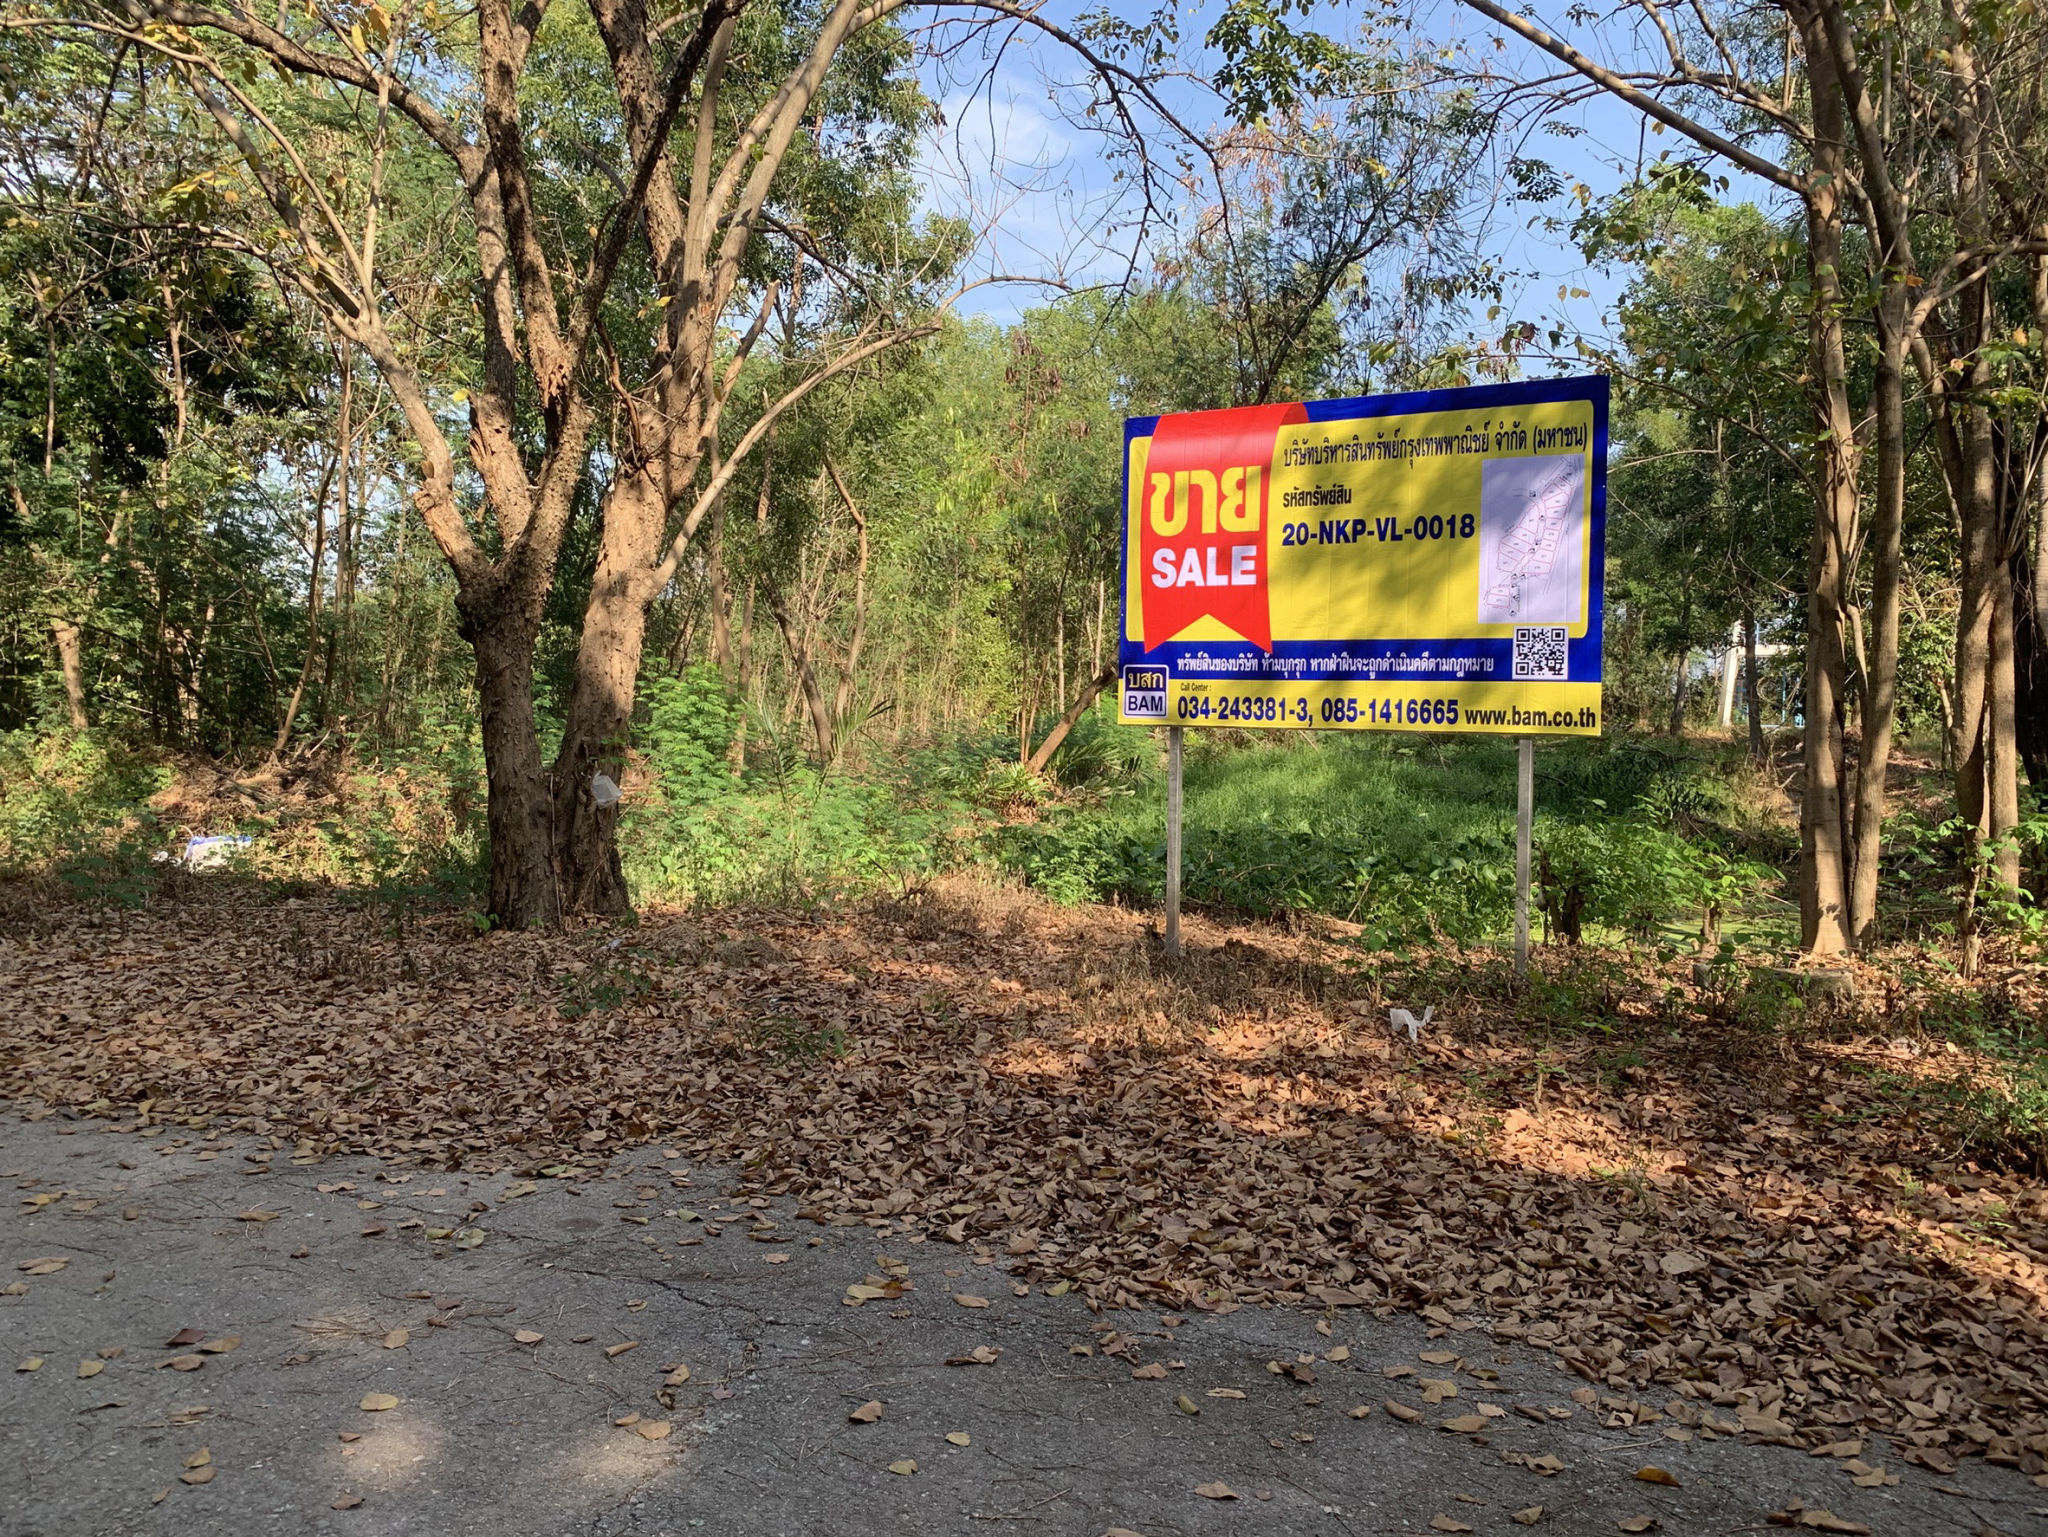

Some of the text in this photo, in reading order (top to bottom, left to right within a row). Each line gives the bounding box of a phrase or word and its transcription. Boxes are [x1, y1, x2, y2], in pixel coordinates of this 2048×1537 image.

[1495, 420, 1527, 451] จำกัด
[1533, 422, 1588, 454] (มหาชน)
[1150, 465, 1261, 537] ขาย
[1283, 484, 1352, 507] รหัสทรัพย์สิน
[1282, 513, 1475, 547] 20-NKP-VL-0018
[1151, 545, 1257, 589] SALE
[1261, 652, 1306, 679] ห้ามบุกรุก
[1128, 671, 1163, 689] บสก
[1180, 682, 1190, 692] Call
[1128, 695, 1163, 712] BAM
[1178, 695, 1459, 727] 034-243381-3, 085-1416665
[1465, 705, 1596, 728] www.bam.co.th
